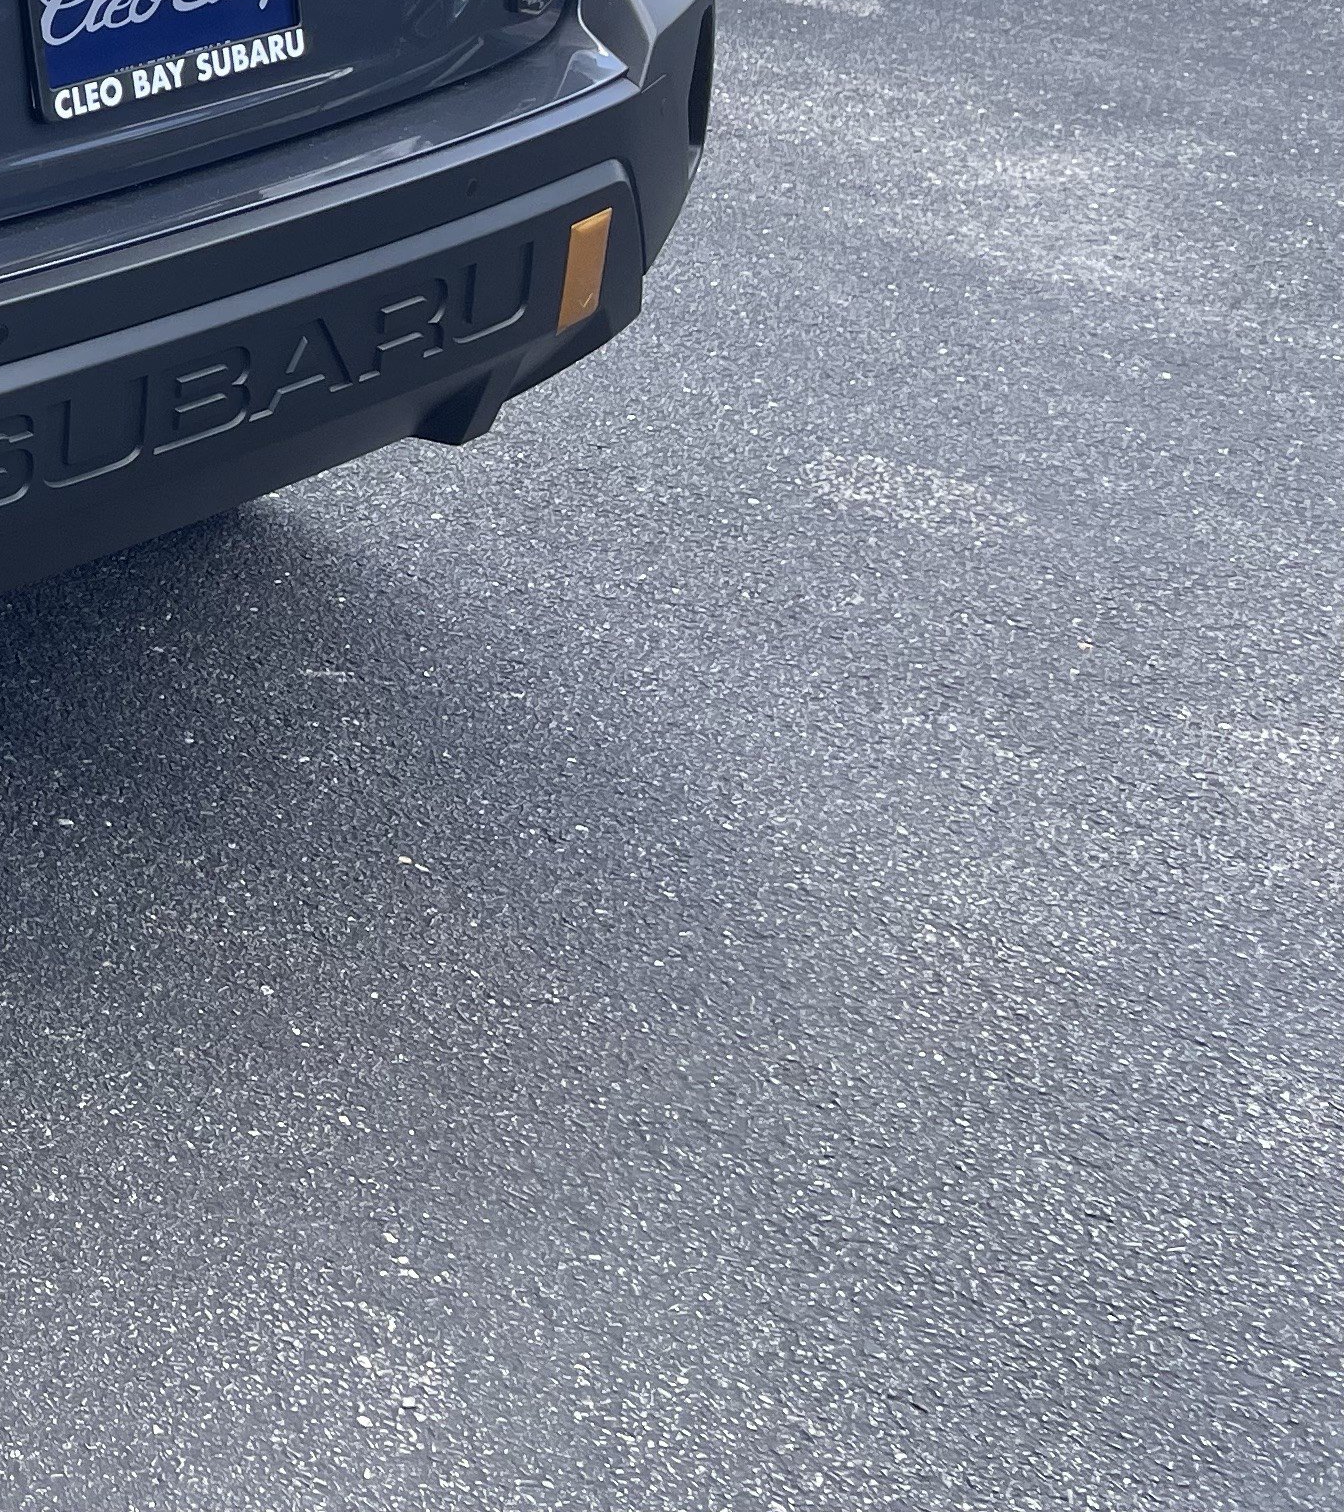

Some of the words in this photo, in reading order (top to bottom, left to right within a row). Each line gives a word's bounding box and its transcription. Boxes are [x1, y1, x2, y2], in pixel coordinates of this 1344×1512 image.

[54, 76, 123, 119] CLEO
[132, 58, 185, 99] BAY
[196, 28, 305, 82] SUBARU
